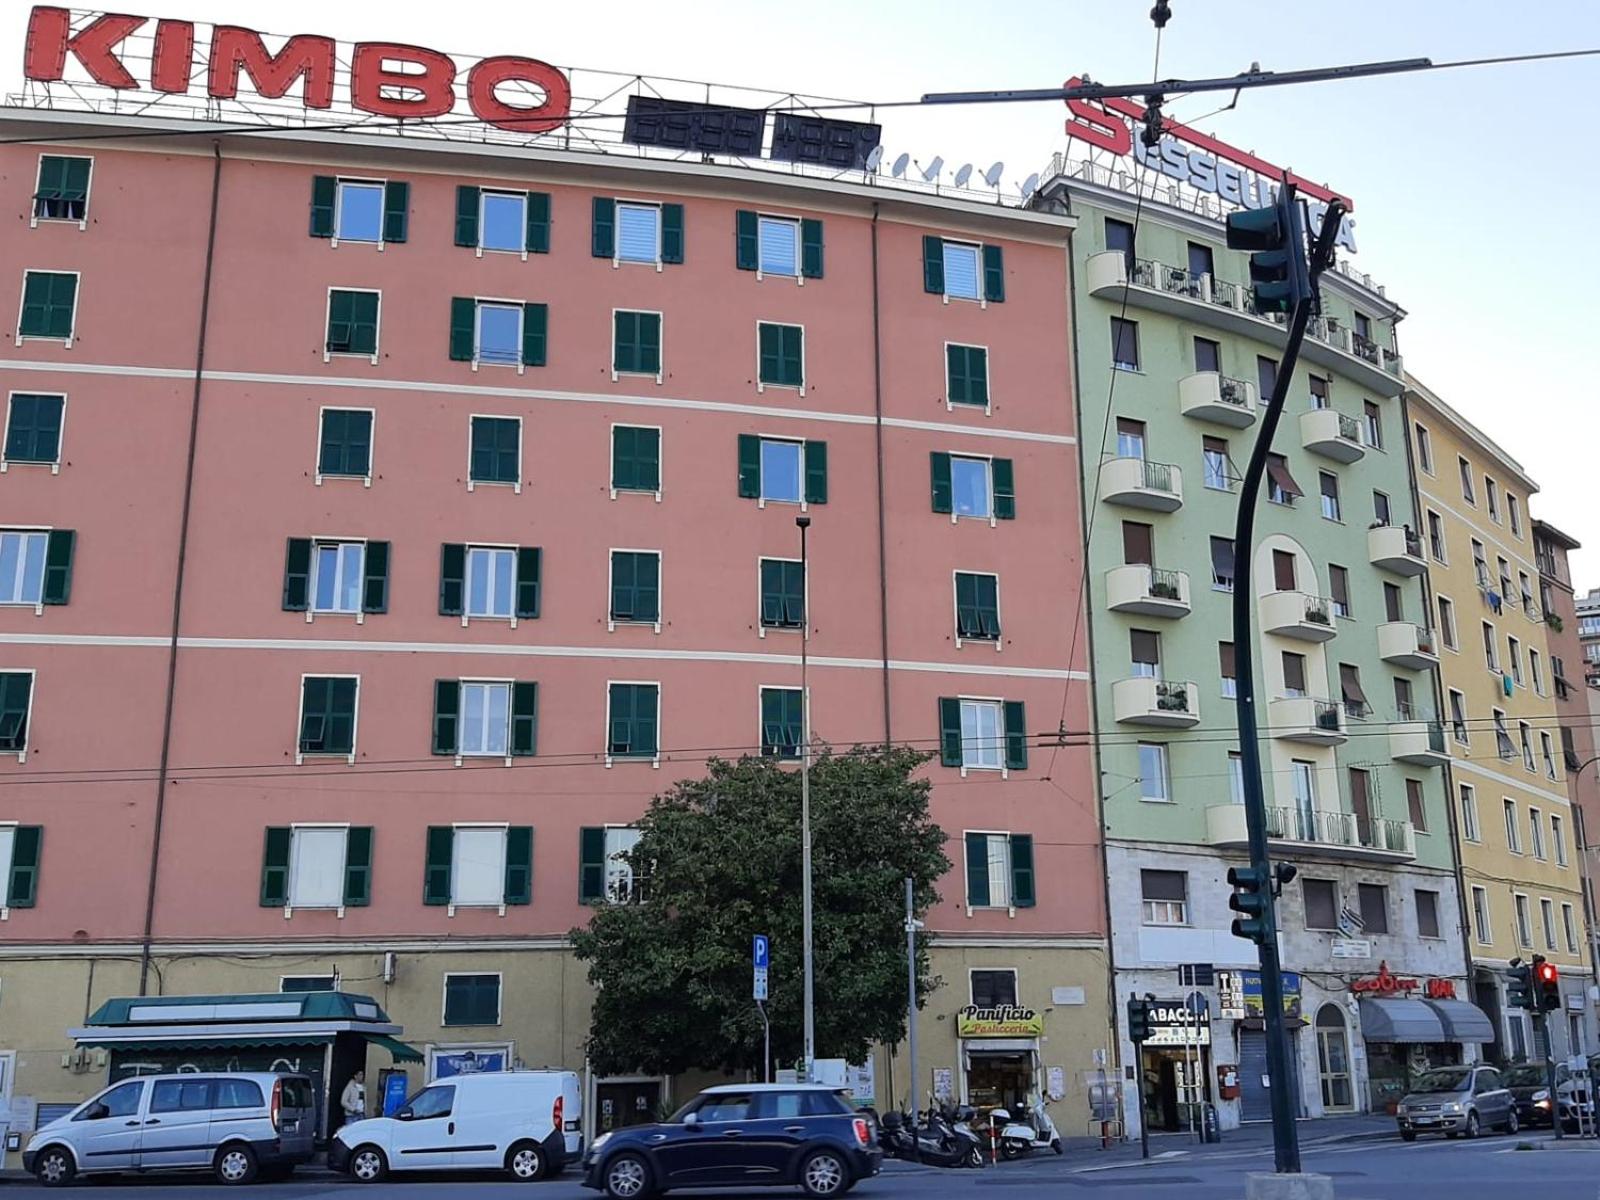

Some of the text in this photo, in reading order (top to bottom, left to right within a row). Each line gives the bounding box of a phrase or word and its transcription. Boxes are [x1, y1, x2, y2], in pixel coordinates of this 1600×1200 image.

[23, 5, 571, 133] KIMBO
[1133, 126, 1358, 253] ESSELUGA
[756, 939, 765, 964] P
[963, 1004, 1036, 1025] Panificio
[1149, 1007, 1209, 1022] ABACCI
